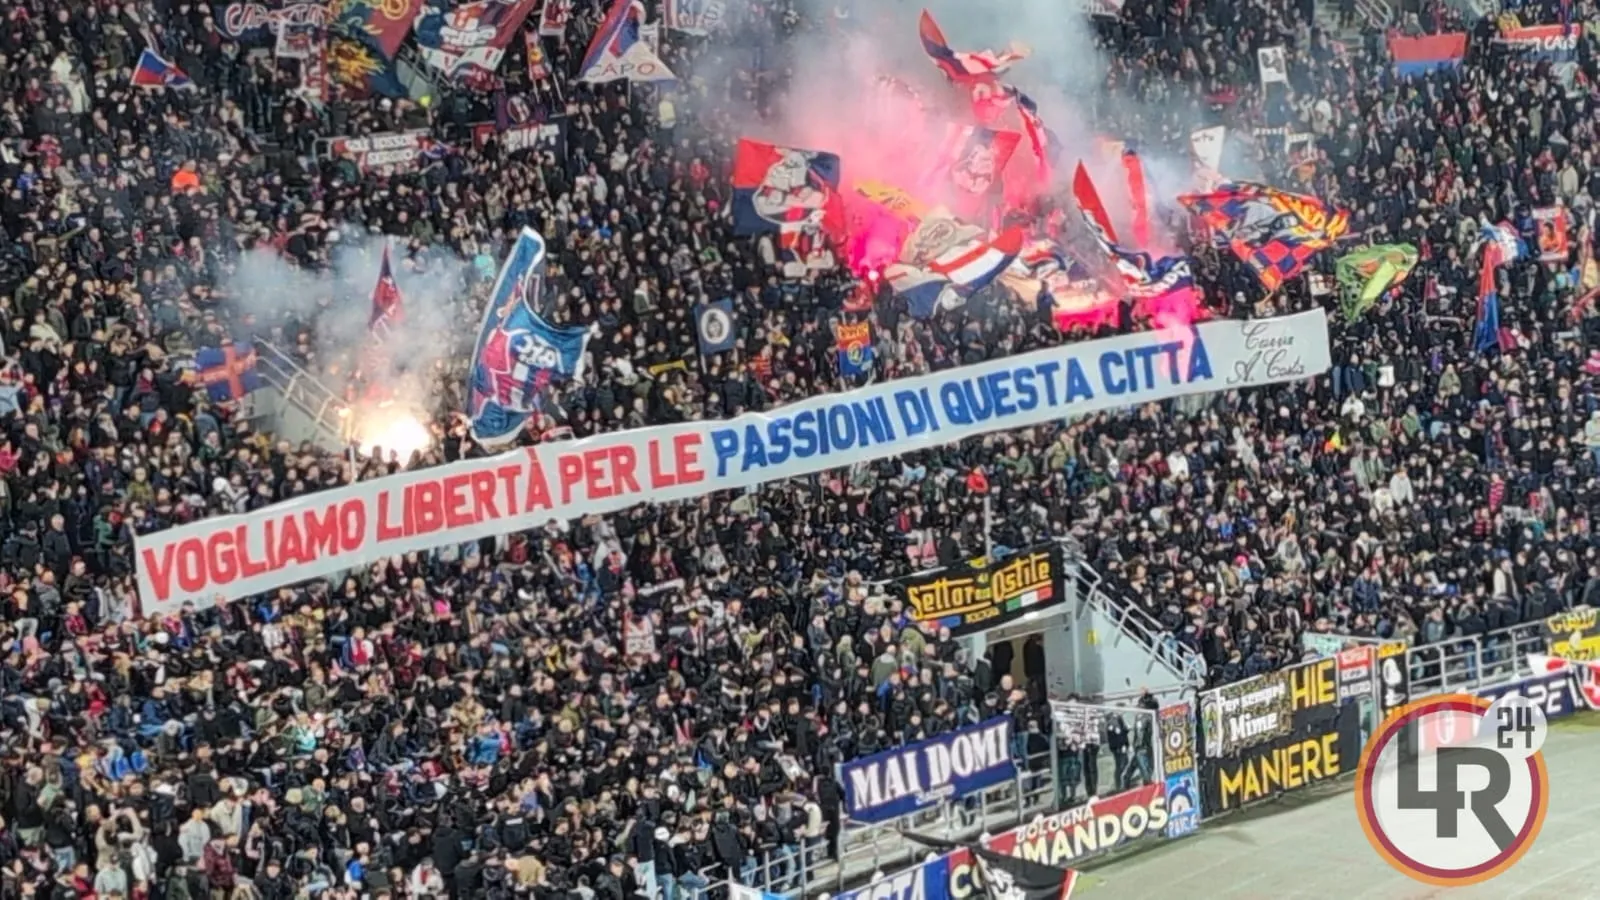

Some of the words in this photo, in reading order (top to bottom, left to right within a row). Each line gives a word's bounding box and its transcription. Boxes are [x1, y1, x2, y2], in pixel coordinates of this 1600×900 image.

[142, 497, 367, 602] VOGLIAMO
[376, 447, 553, 543] LIBERTÀ
[558, 444, 641, 505] PER
[648, 432, 705, 489] LE
[710, 396, 897, 477] PASSIONI
[894, 387, 940, 437] DI
[940, 357, 1094, 425] QUESTA
[992, 552, 1052, 604] Ostile
[1230, 711, 1278, 742] Mime
[850, 751, 922, 811] MAI
[925, 721, 1009, 787] DOMI
[1220, 732, 1340, 809] MANIERE
